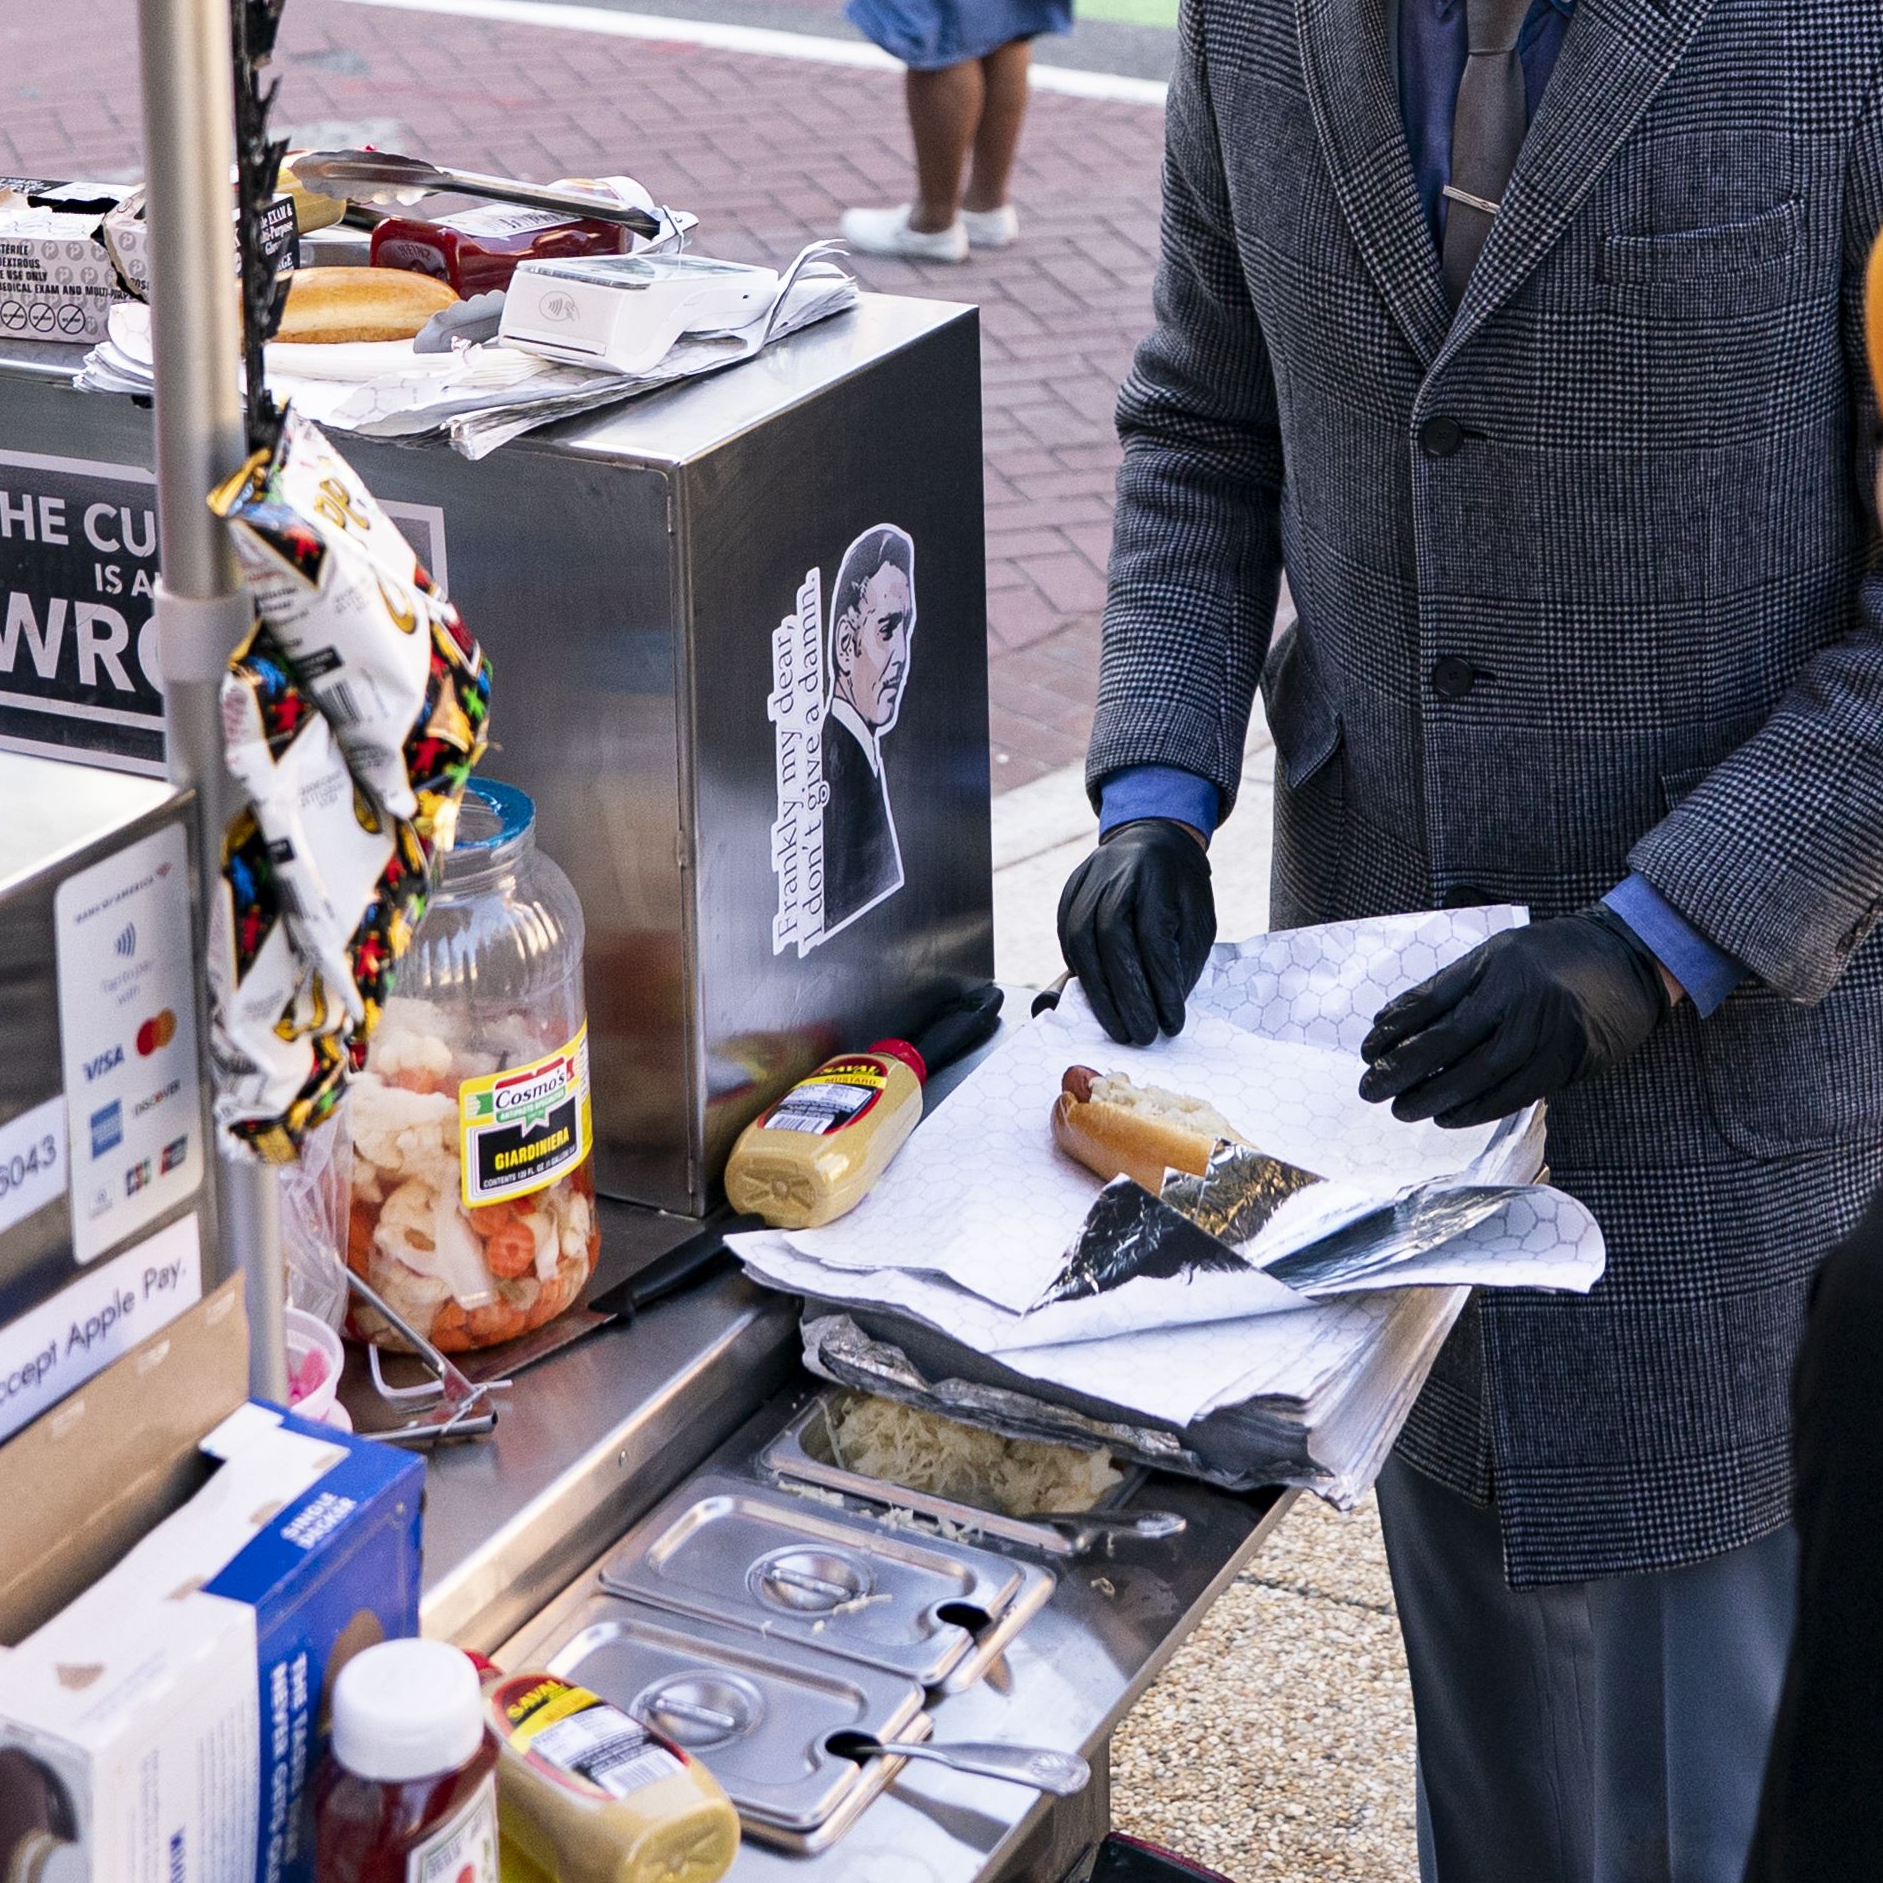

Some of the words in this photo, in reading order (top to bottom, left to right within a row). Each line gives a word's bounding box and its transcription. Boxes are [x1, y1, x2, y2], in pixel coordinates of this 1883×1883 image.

[268, 204, 287, 226] EXAM
[398, 243, 431, 260] HEINZ
[6, 271, 23, 280] USE
[25, 271, 48, 282] ONLY
[34, 284, 60, 294] EXAM
[62, 285, 82, 295] AND
[94, 563, 123, 595] IS
[797, 576, 819, 694] damn.
[773, 625, 796, 714] dear,
[805, 703, 820, 725] a
[781, 730, 803, 786] my
[801, 733, 829, 811] give
[776, 800, 804, 939] Frankly
[802, 819, 823, 916] don't
[803, 925, 823, 943] I
[83, 1044, 125, 1082] VISA
[824, 1077, 877, 1086] MUSTARD
[133, 1078, 182, 1118] DISCOVER
[495, 1069, 565, 1110] Cosmo's
[495, 1127, 570, 1171] GIARDINIERA
[483, 1171, 517, 1188] CONTENTS
[66, 1287, 135, 1356] Apple
[142, 1258, 187, 1300] Pay.
[280, 1491, 340, 1540] SINGLE
[270, 1660, 289, 1762] NEVER
